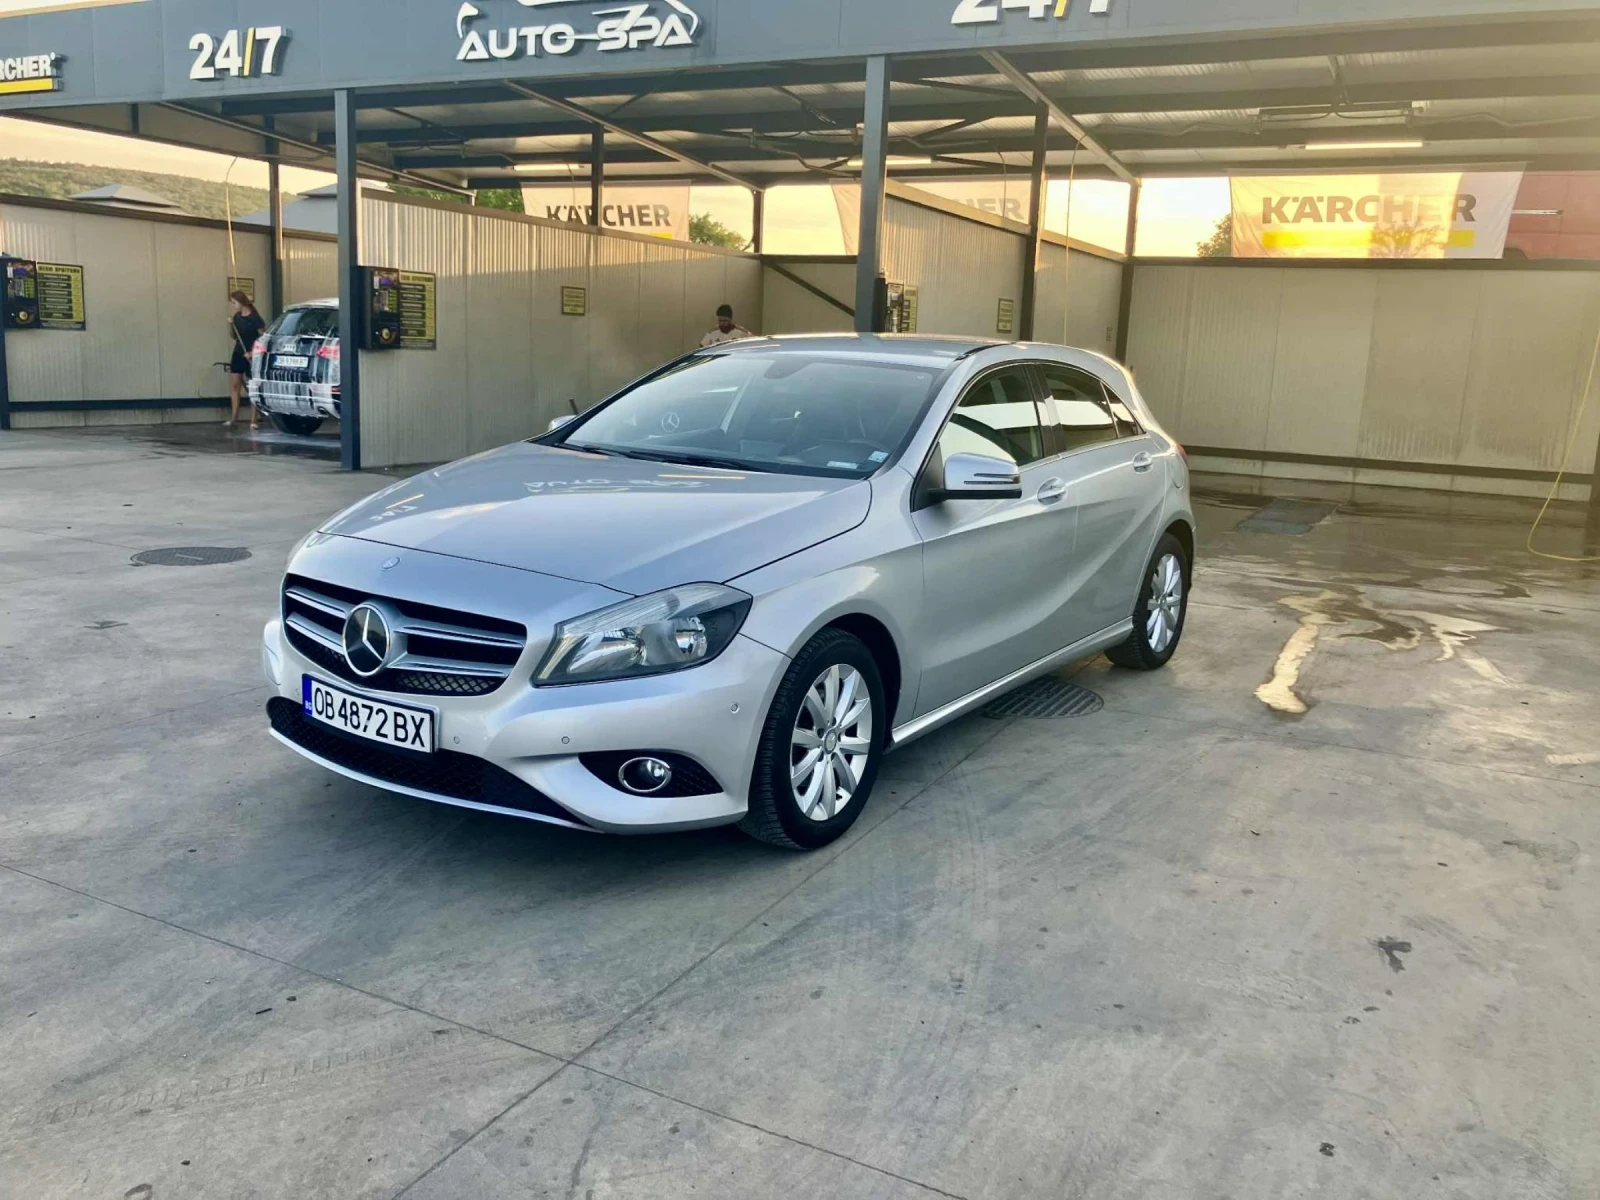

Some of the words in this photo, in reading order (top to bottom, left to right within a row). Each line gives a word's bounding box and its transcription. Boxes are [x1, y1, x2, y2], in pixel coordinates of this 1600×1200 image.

[189, 26, 282, 80] 24/7
[456, 24, 575, 60] AUTO
[592, 5, 693, 51] SPA
[1262, 193, 1477, 225] KÄRCHER
